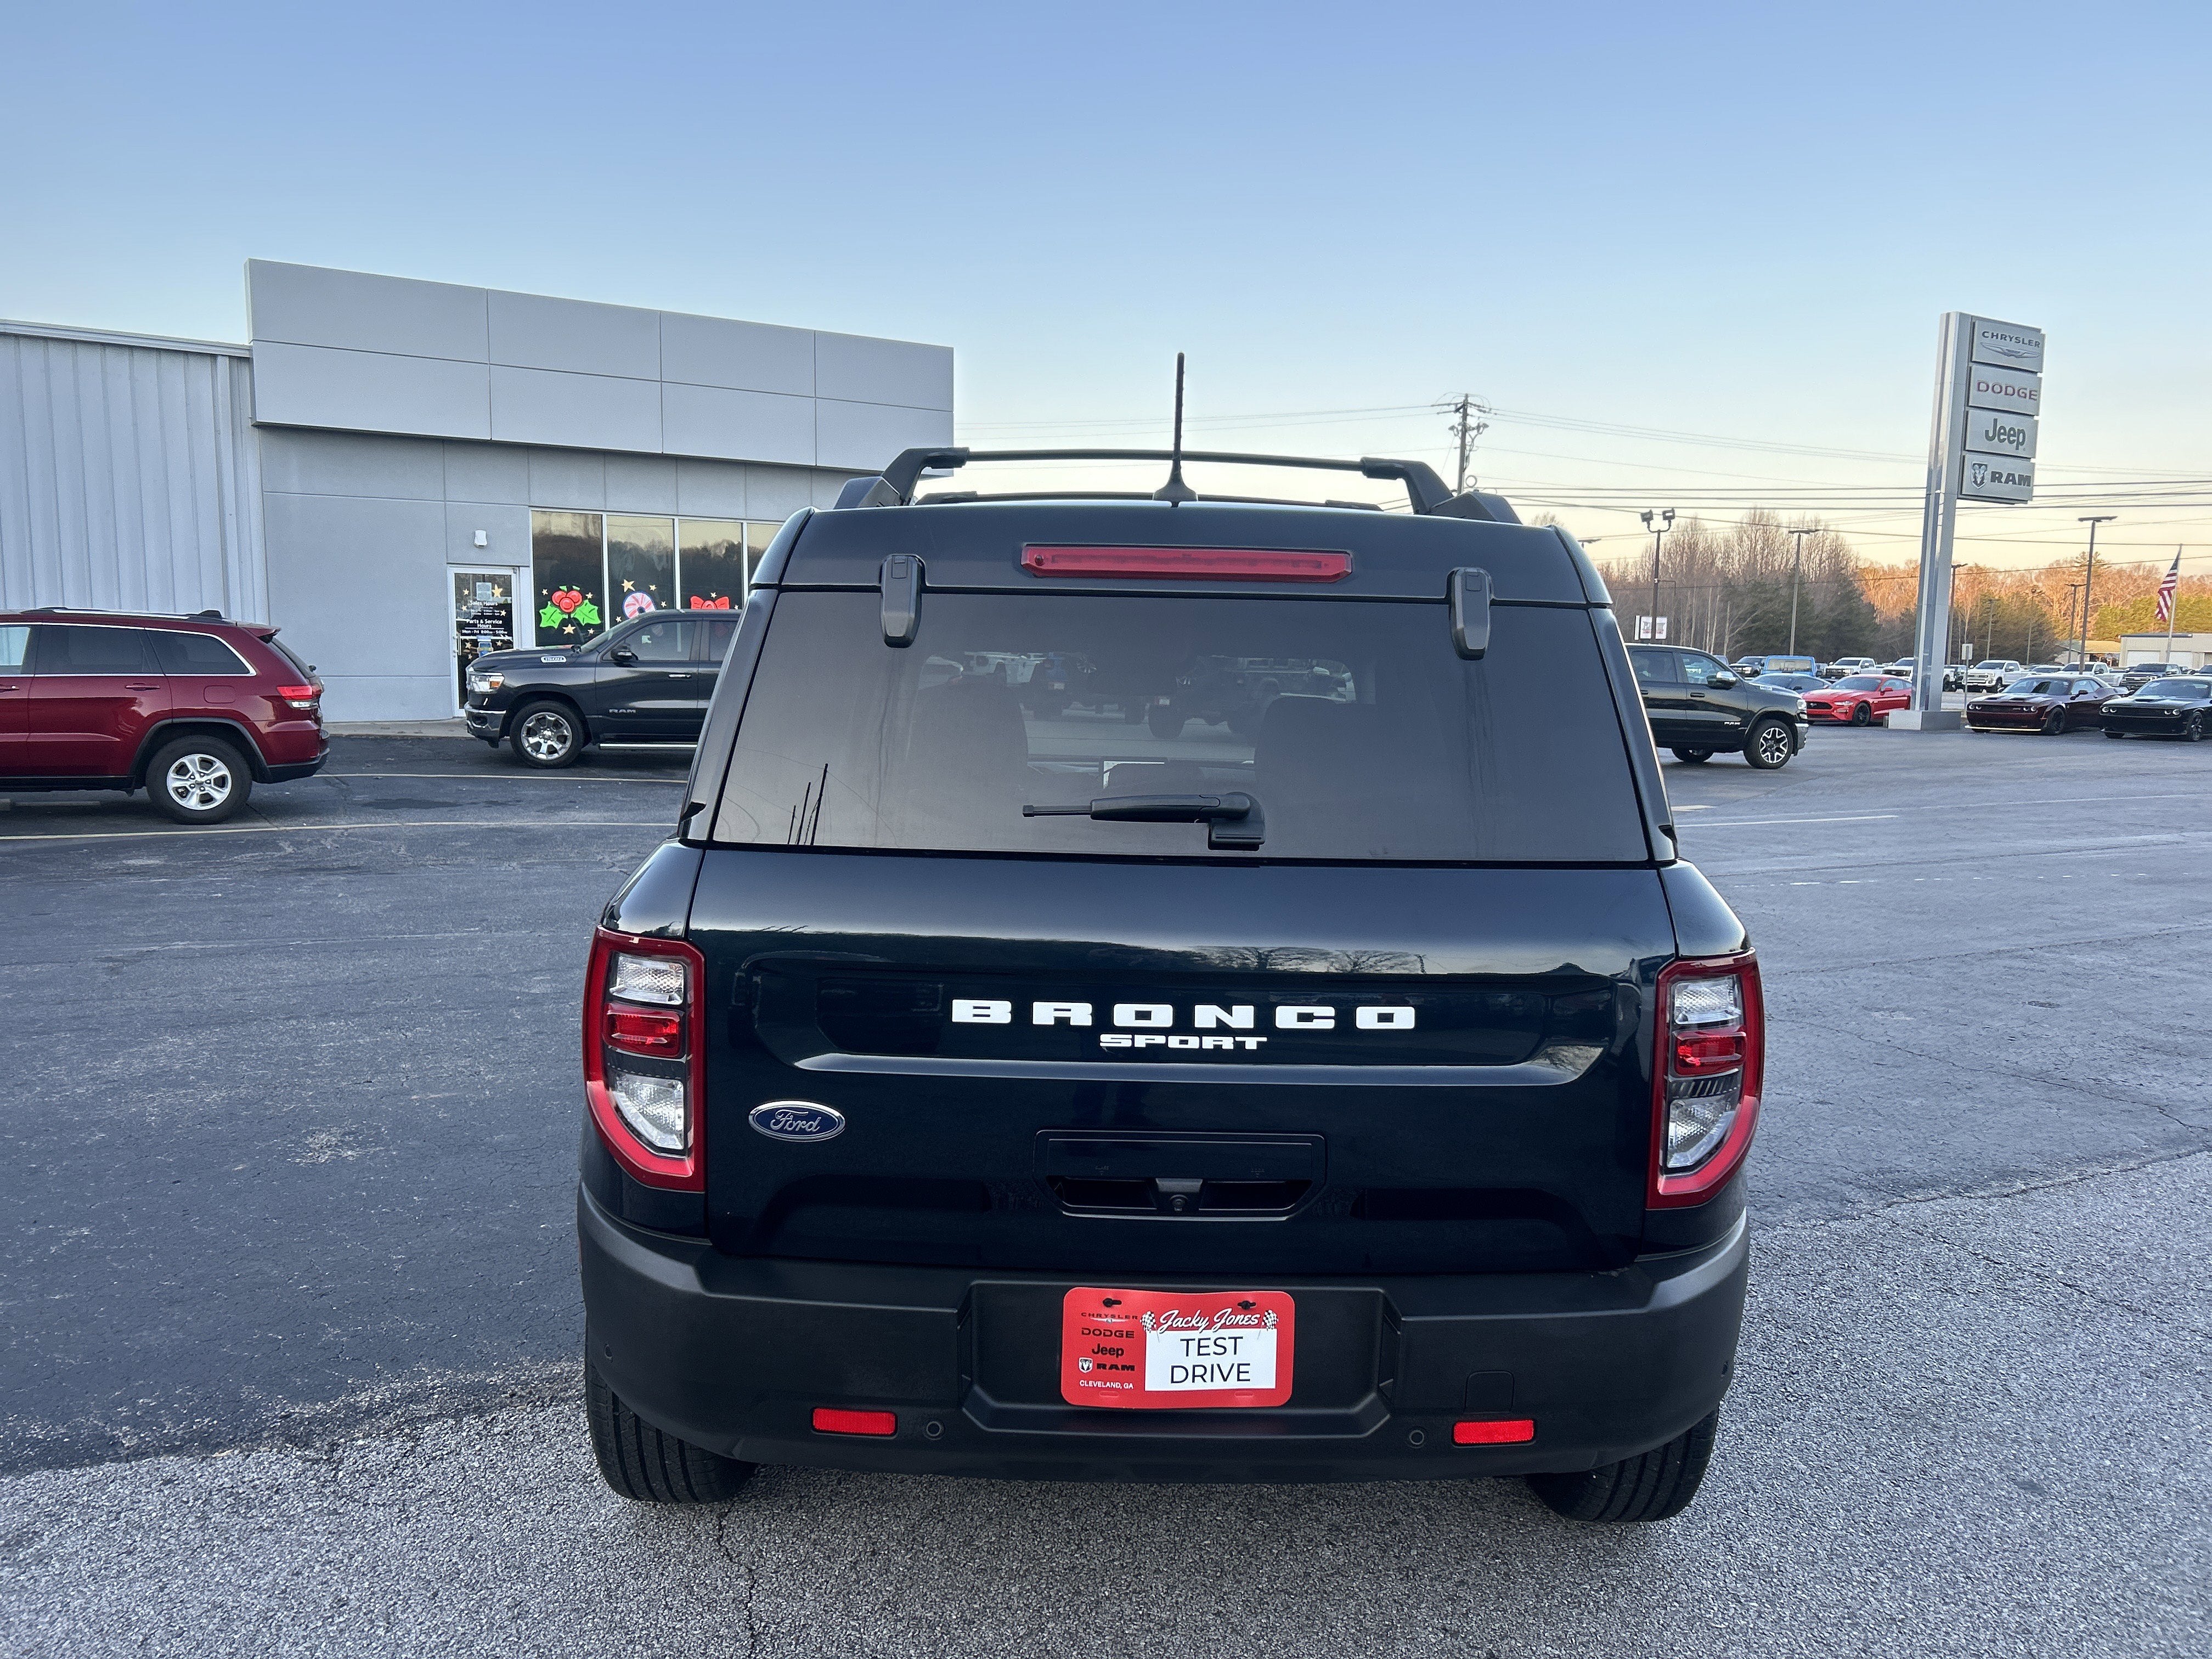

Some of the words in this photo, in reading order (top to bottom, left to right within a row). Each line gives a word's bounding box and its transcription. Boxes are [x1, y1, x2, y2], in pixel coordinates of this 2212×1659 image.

[1982, 330, 2041, 348] CHRYSLER
[1977, 380, 2039, 402] DODGE
[1984, 417, 2026, 450] Jeep
[1990, 471, 2031, 487] RAM
[952, 998, 1415, 1030] BRONCO
[1099, 1034, 1268, 1049] SPORT
[770, 1109, 822, 1132] Ford
[1081, 1312, 1138, 1320] CHRYSLER
[1158, 1308, 1210, 1334] Jacky
[1211, 1307, 1261, 1333] Jones
[1081, 1328, 1135, 1339] DODGE
[1091, 1343, 1125, 1358] Jeep
[1180, 1336, 1244, 1357] TEST
[1096, 1362, 1135, 1372] RAM
[1170, 1362, 1251, 1384] DRIVE
[1079, 1380, 1122, 1390] CLEVELAND,
